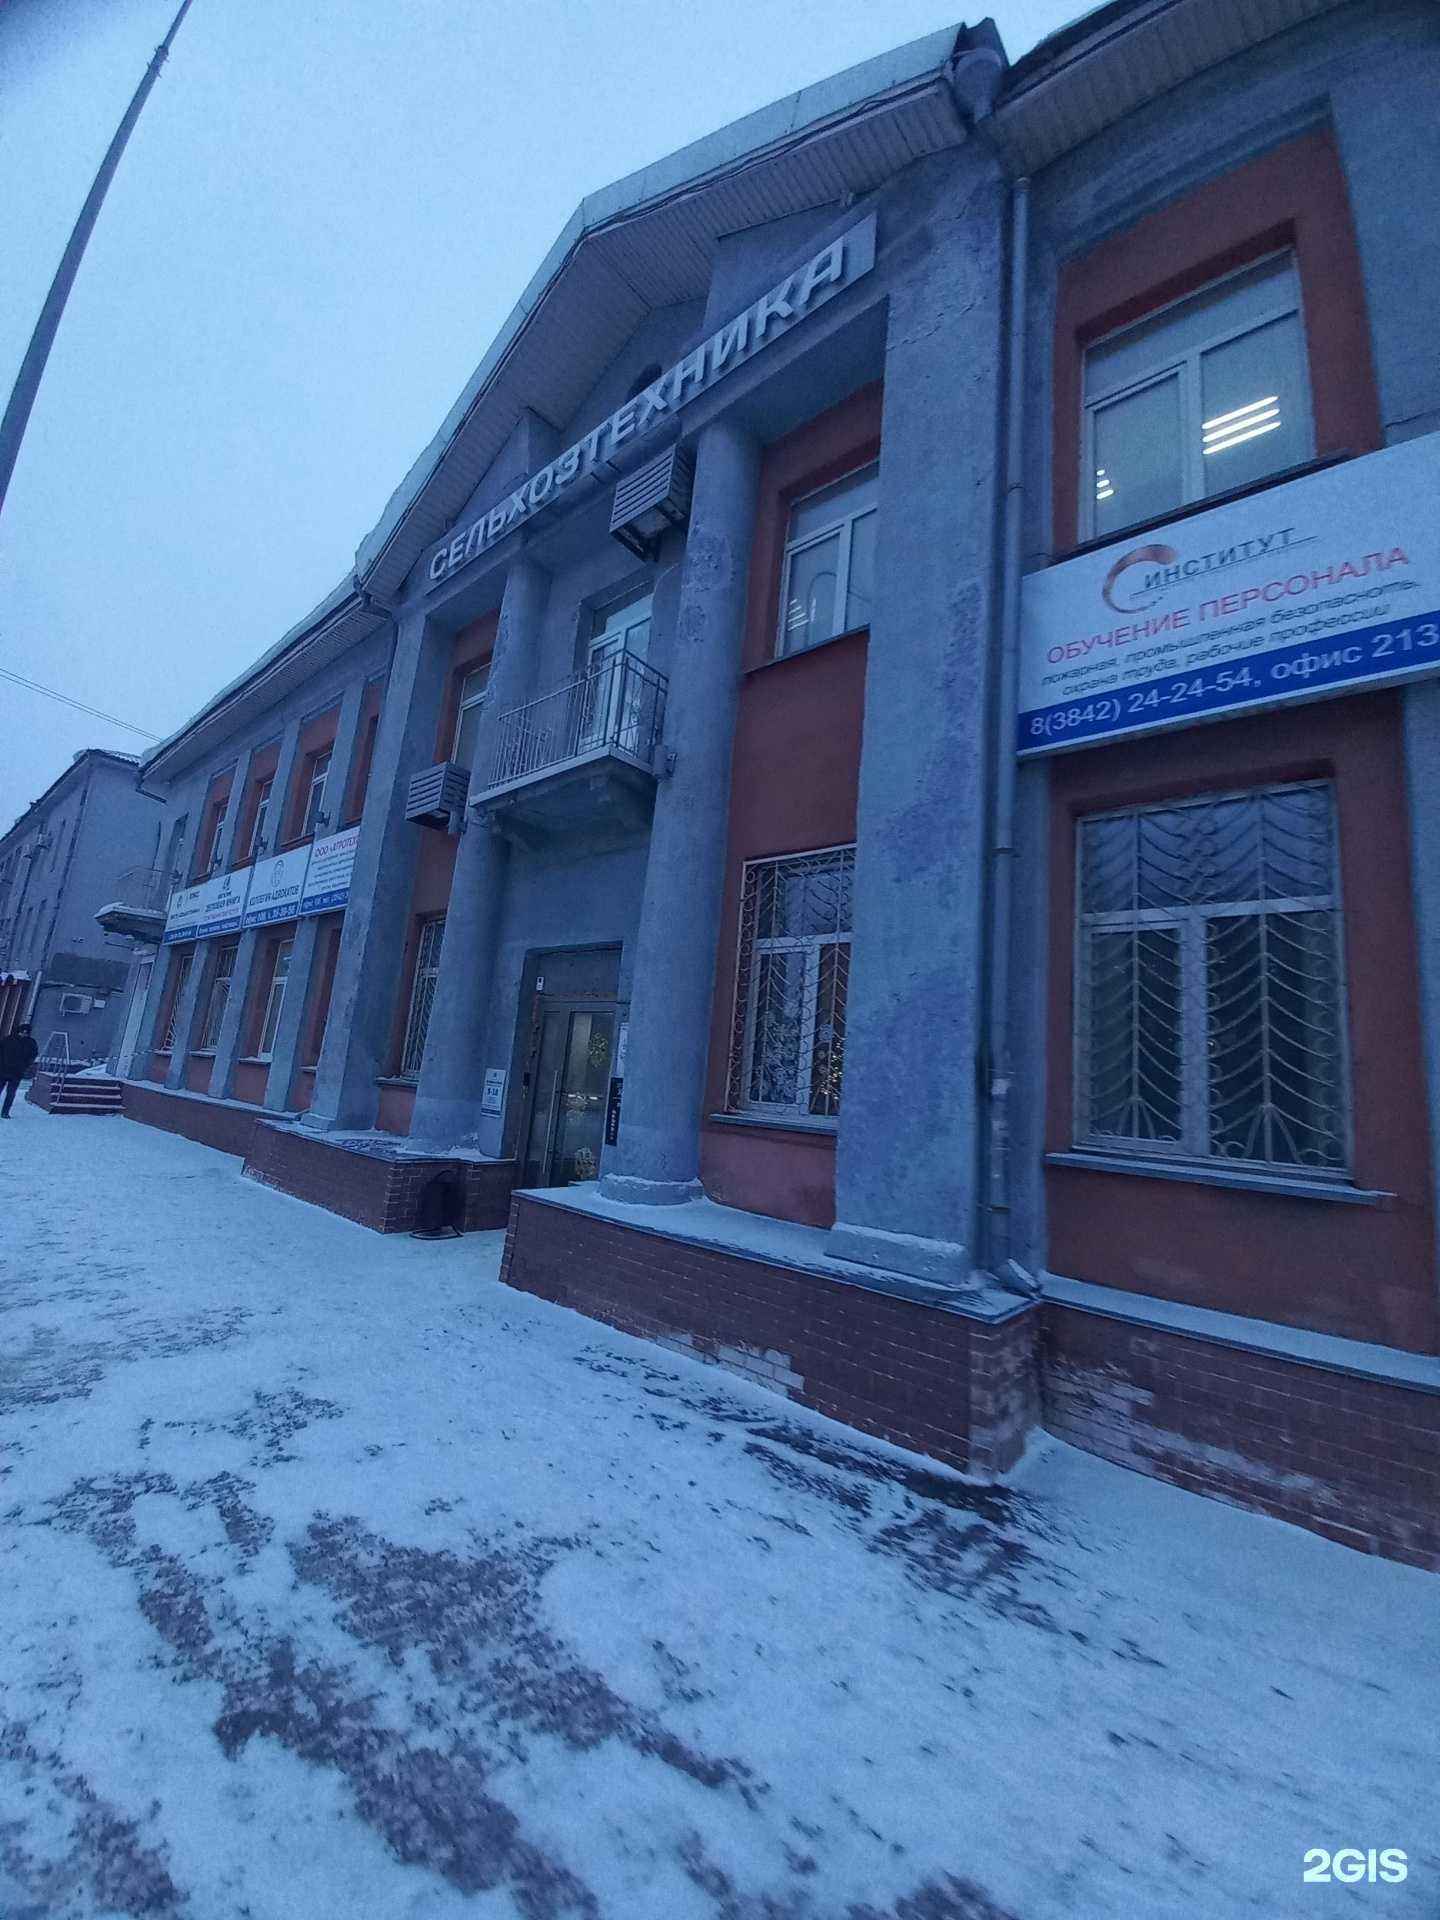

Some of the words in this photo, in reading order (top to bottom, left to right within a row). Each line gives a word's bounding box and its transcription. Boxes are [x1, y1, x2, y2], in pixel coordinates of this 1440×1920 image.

[430, 236, 845, 580] СЕЛЬХОЗТЕХНИКА
[1046, 608, 1191, 664] ОБУЧЕНИЕ
[1200, 547, 1410, 622] ПЕРСОНАЛА
[1143, 527, 1295, 589] ИНСТИТУТ
[1029, 698, 1121, 736] 8(3842)
[1128, 667, 1263, 714] 24-24-54,
[1271, 647, 1363, 681] офис
[1371, 624, 1440, 659] 213
[1062, 674, 1118, 696] охрана
[1185, 633, 1265, 666] рабочие
[1269, 605, 1391, 642] профессии
[1124, 618, 1266, 664] промышленная
